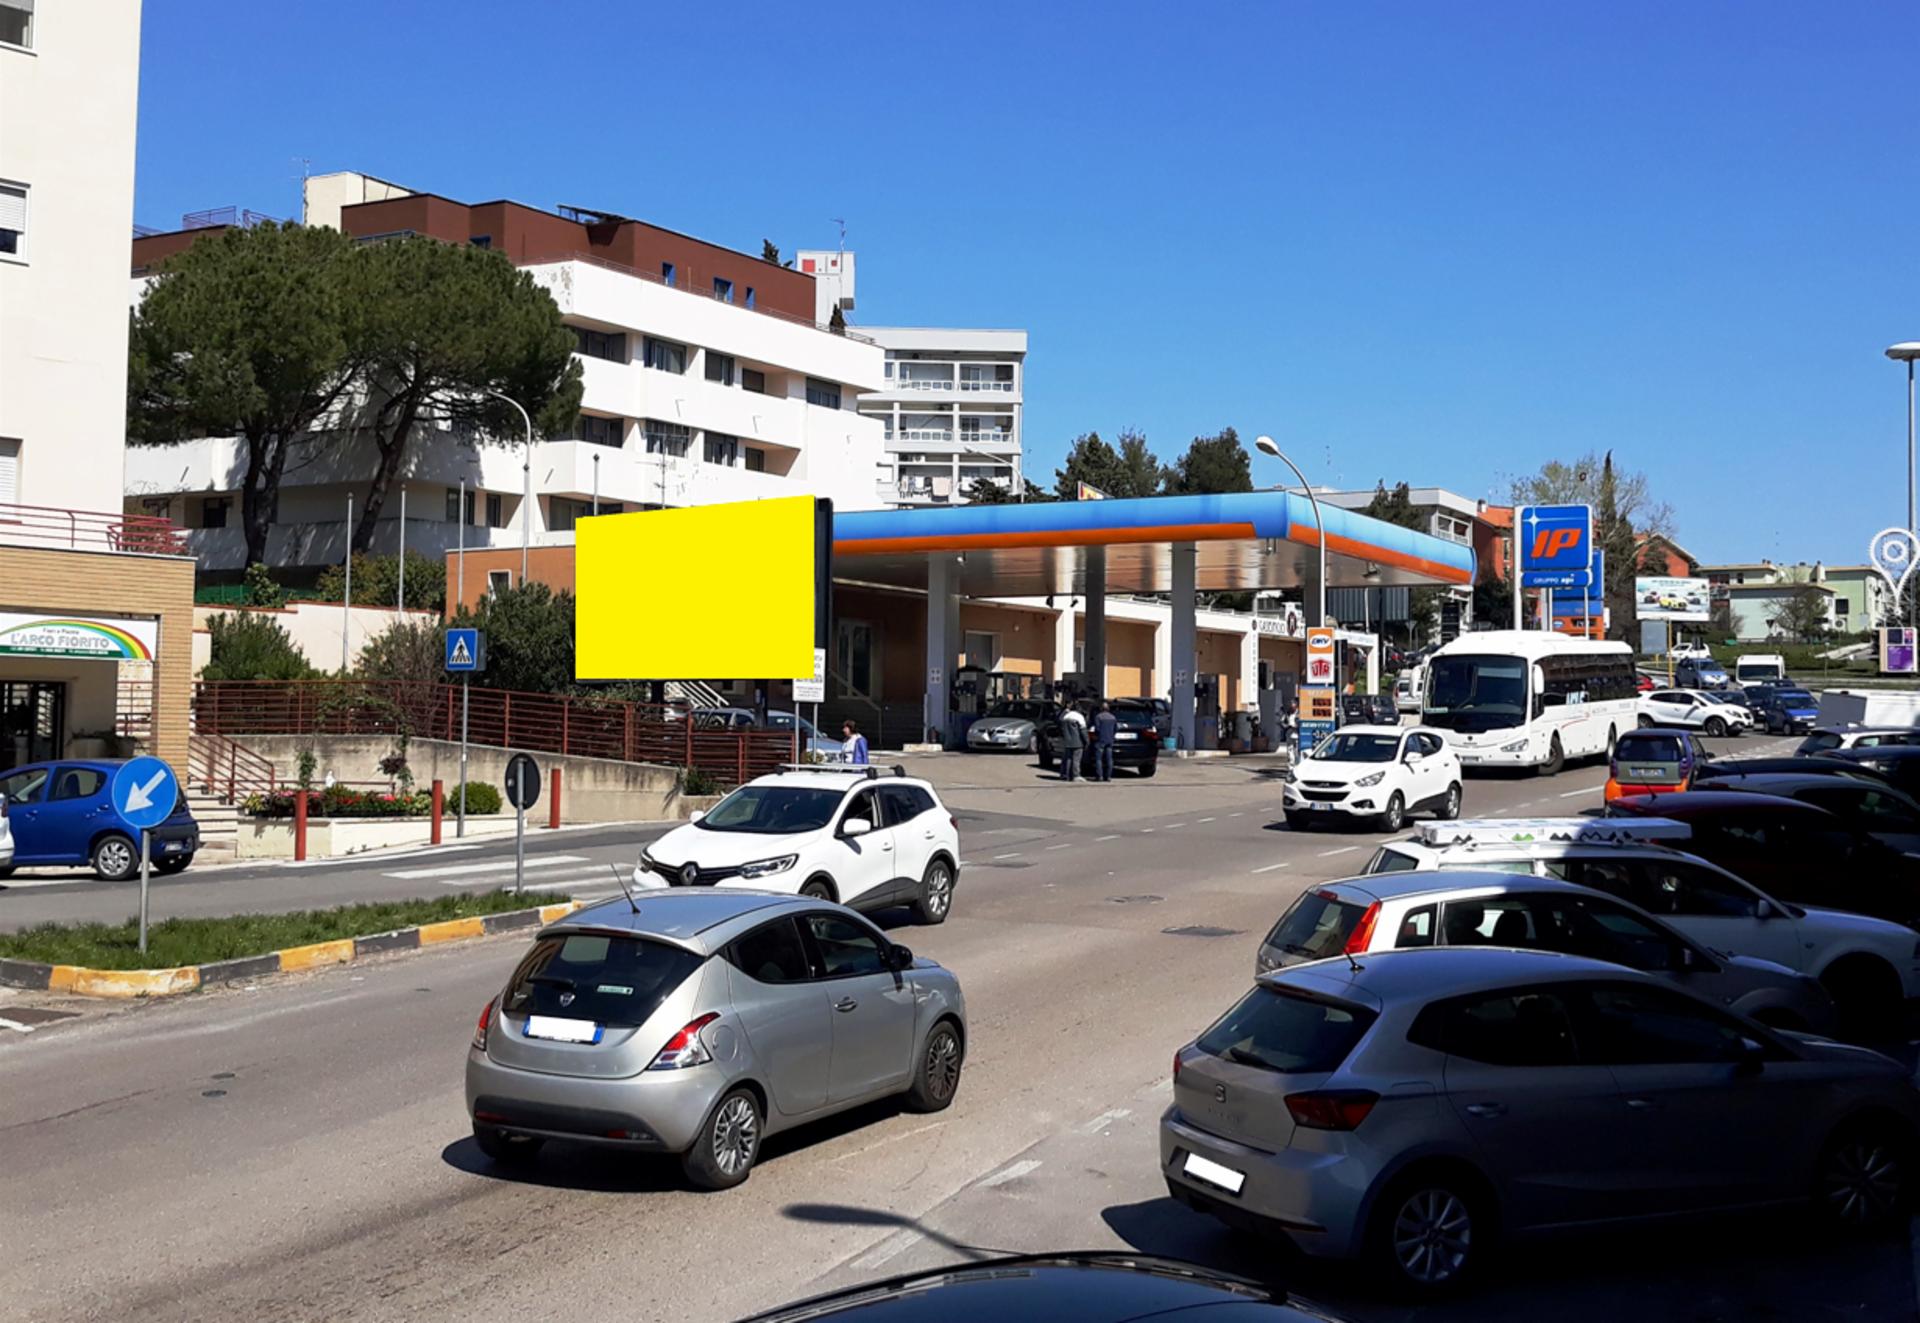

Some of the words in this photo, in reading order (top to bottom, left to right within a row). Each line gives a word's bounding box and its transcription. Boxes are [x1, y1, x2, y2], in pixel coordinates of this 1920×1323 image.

[1531, 528, 1581, 558] IP
[11, 633, 54, 646] L'ARCO
[58, 635, 109, 648] FIORITO
